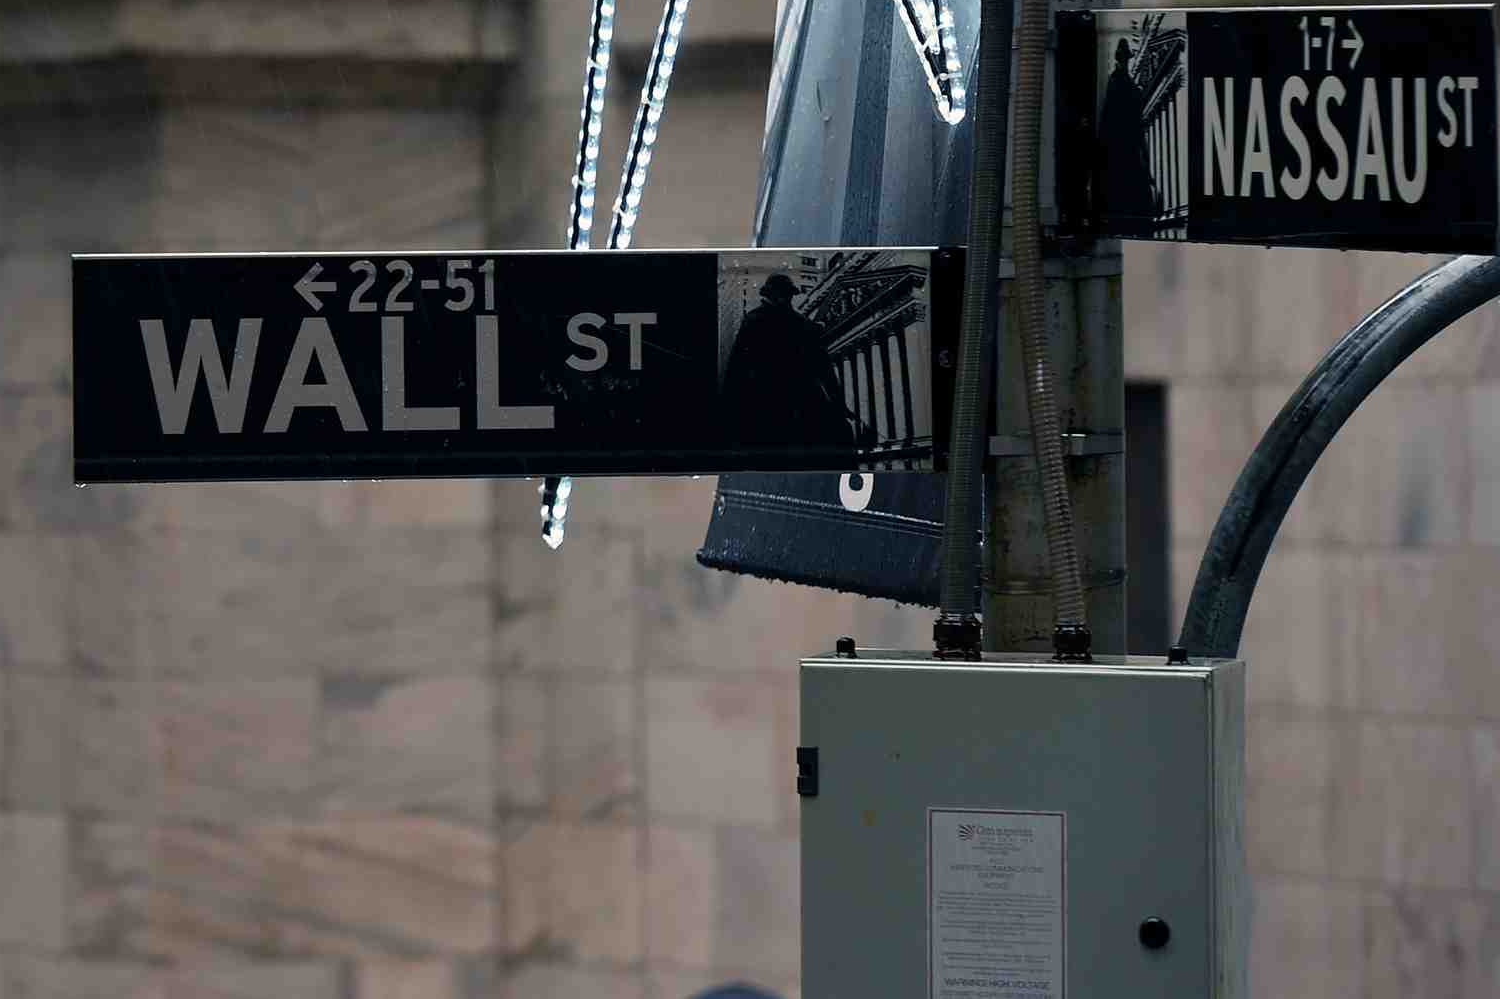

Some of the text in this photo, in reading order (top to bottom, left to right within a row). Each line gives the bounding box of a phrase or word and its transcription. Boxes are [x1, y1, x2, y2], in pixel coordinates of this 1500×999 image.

[1298, 15, 1336, 71] 1-7
[1203, 75, 1479, 204] NASSAU ST
[348, 259, 496, 313] 22-51
[139, 312, 658, 436] WALL ST
